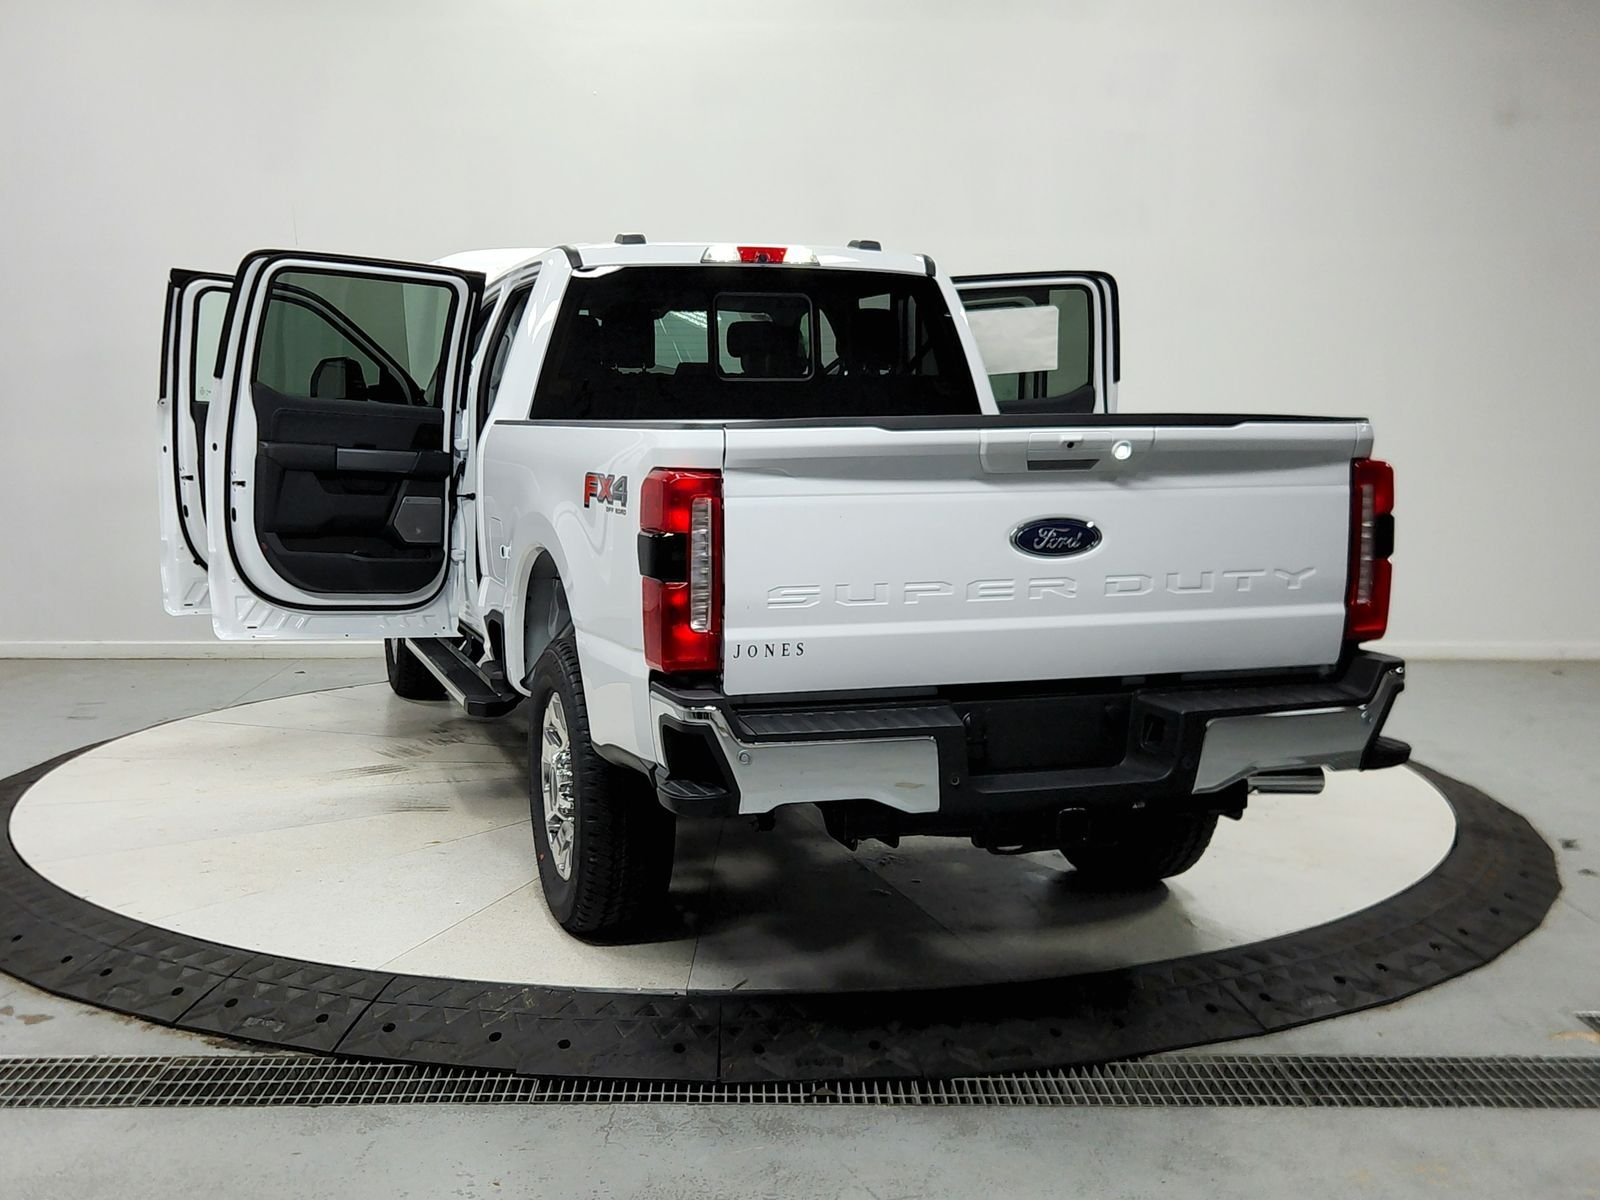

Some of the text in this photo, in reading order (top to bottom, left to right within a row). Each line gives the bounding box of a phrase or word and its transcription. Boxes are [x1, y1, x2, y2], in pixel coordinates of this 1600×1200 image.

[583, 471, 628, 508] FX4
[1033, 526, 1082, 550] Ford
[767, 567, 1317, 609] SUPER DUTY
[732, 642, 804, 659] JONES
